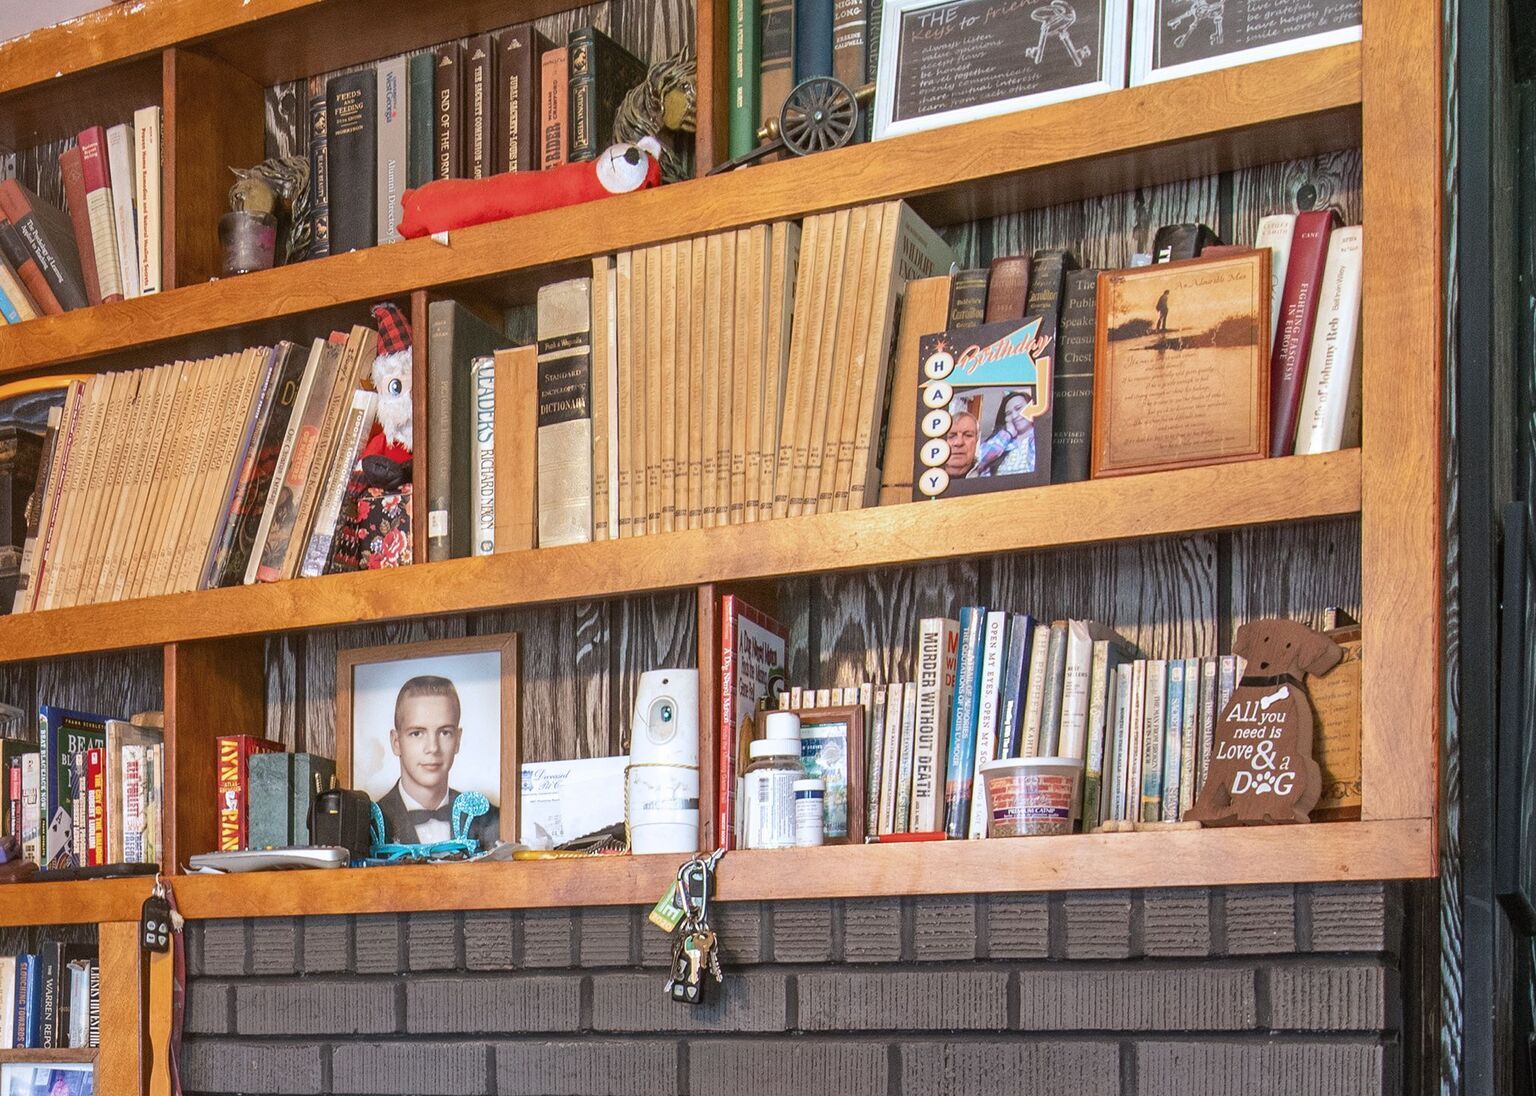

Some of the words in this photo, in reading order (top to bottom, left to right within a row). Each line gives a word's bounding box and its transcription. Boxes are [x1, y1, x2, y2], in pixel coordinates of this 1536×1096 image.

[918, 6, 959, 28] THE
[1247, 13, 1260, 21] be
[1263, 3, 1313, 20] grateful
[912, 24, 955, 42] Keys
[959, 16, 981, 29] to
[922, 41, 960, 53] always
[922, 52, 950, 61] value
[474, 66, 482, 82] THE
[920, 76, 950, 87] travel
[954, 67, 997, 80] together
[921, 71, 933, 79] be
[937, 64, 971, 75] honest
[958, 68, 1033, 86] communicate
[336, 89, 361, 101] FEEDS
[441, 89, 449, 111] END
[474, 84, 482, 115] SACKETT
[510, 76, 518, 100] JUBAL
[334, 102, 363, 115] FEEDING
[441, 114, 449, 128] OF
[441, 131, 449, 151] THE
[474, 117, 482, 161] COMPANION
[509, 138, 518, 160] LOUIS
[546, 123, 561, 162] RIDER
[388, 160, 396, 193] Alumni
[25, 219, 36, 232] The
[387, 195, 396, 235] Directory
[19, 224, 35, 244] Applied
[30, 229, 50, 257] Psychology
[30, 242, 39, 250] to
[33, 248, 51, 270] Teaching
[46, 254, 54, 262] of
[48, 260, 66, 284] Learning
[1076, 280, 1094, 290] The
[1288, 304, 1296, 316] IN
[1292, 283, 1309, 334] FIGHTING
[1280, 320, 1294, 360] EUROPE
[1318, 344, 1334, 384] Johnny
[1327, 318, 1339, 340] Reb
[957, 333, 1052, 375] Birthday
[1065, 353, 1091, 363] Chest
[1284, 338, 1299, 380] FASCISM
[545, 369, 582, 381] STANDARD
[322, 395, 342, 438] Wonderful
[477, 367, 494, 442] LEADERS
[540, 397, 586, 416] DICTIONARY
[348, 410, 363, 445] FODOR'S
[314, 440, 328, 465] World
[339, 448, 354, 481] LONDON
[481, 449, 494, 496] RICHARD
[481, 499, 494, 531] NIXON
[990, 622, 999, 648] OPEN
[1037, 633, 1047, 657] THE
[722, 656, 730, 670] Dog
[922, 633, 938, 687] MURDER
[958, 644, 969, 693] QUOTATIONS
[988, 653, 997, 667] MY
[723, 672, 731, 696] Named
[965, 662, 974, 684] TRAIL
[965, 686, 973, 697] OF
[1031, 661, 1045, 714] PROPHET
[958, 695, 966, 705] OF
[919, 692, 935, 751] WITHOUT
[956, 707, 965, 730] LOUIS
[961, 699, 973, 739] MEMORIES
[982, 703, 993, 728] OPEN
[1226, 701, 1259, 722] All
[1258, 712, 1286, 725] you
[68, 735, 104, 752] BEAT
[981, 733, 990, 747] MY
[1233, 726, 1266, 738] need
[1269, 726, 1282, 738] is
[221, 740, 238, 781] AYN
[952, 732, 962, 766] L'AMOUR
[1216, 742, 1253, 759] Love
[1251, 740, 1276, 770] &
[1279, 756, 1290, 770] a
[127, 761, 139, 779] KEN
[916, 756, 932, 798] DEATH
[127, 782, 139, 818] FOLLETT
[19, 962, 27, 1005] SLOUCHING
[91, 967, 99, 997] CRISIS
[45, 978, 53, 1020] WARREN
[90, 1000, 100, 1047] INVESTING
